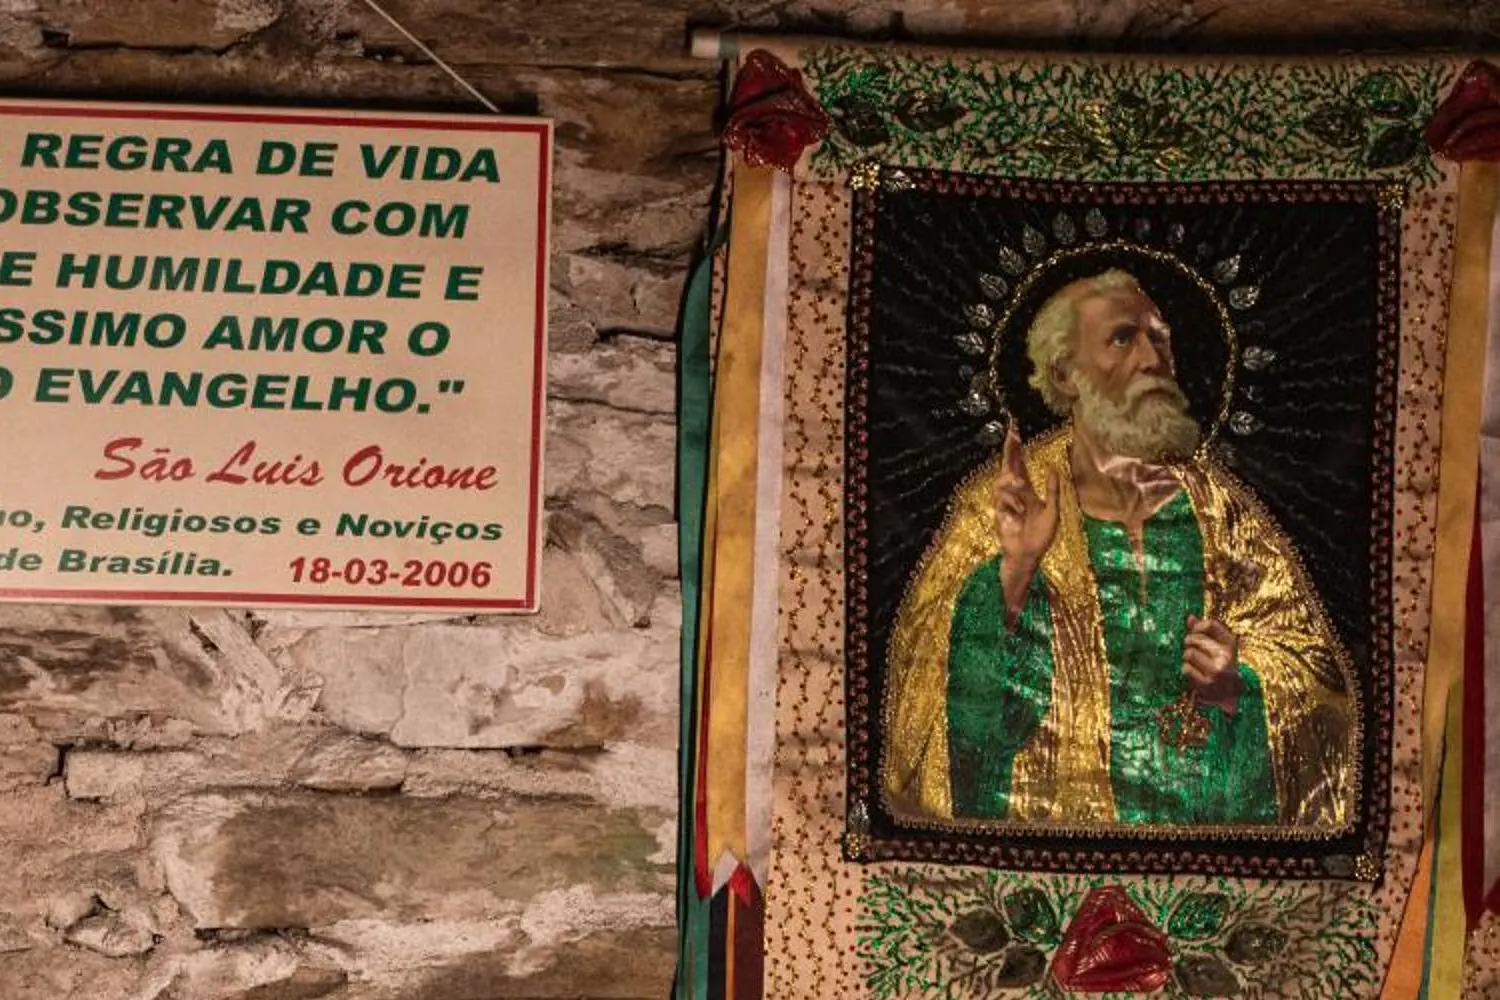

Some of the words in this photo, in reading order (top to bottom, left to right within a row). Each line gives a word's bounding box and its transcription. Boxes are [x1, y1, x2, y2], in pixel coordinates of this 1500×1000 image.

[20, 132, 233, 174] REGRA
[255, 140, 339, 177] DE
[360, 144, 500, 183] VIDA
[331, 200, 471, 239] COM
[56, 253, 426, 299] HUMILDADE
[444, 266, 484, 301] E
[202, 316, 388, 355] AMOR
[408, 322, 451, 357] O
[34, 368, 465, 414] EVANGELHO."
[94, 437, 196, 482] São
[205, 440, 324, 486] Luis
[342, 445, 498, 491] Orione
[61, 506, 282, 538] Religiosos
[296, 518, 321, 536] e
[336, 513, 503, 545] Noviços
[58, 549, 232, 576] Brasília.
[290, 556, 492, 589] 18-03-2006
